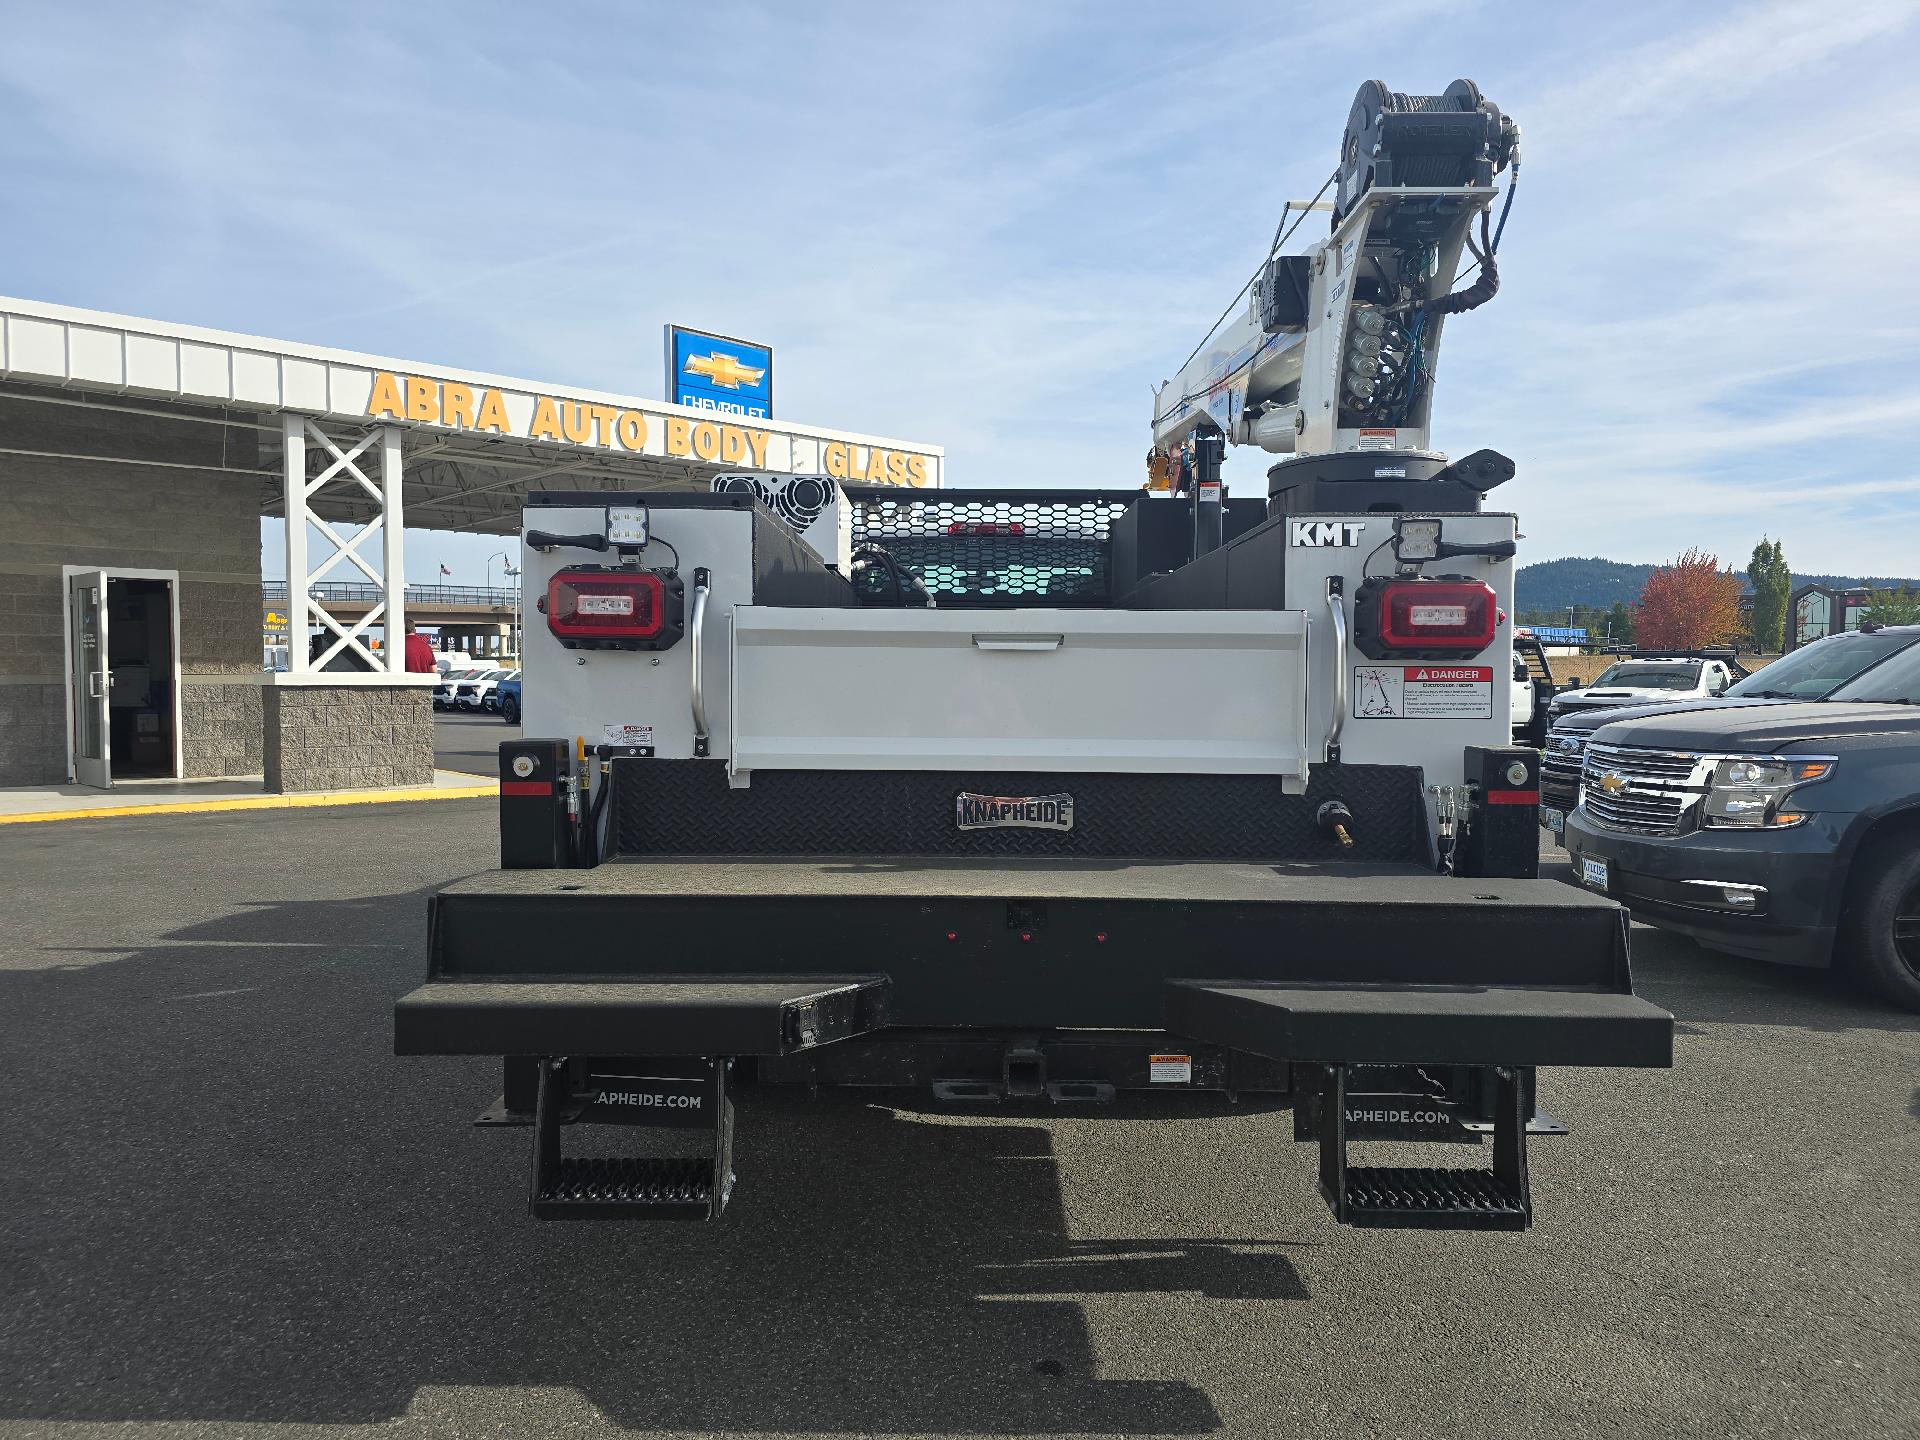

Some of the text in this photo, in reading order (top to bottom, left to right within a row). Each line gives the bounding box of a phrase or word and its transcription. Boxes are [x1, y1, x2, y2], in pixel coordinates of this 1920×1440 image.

[369, 371, 927, 488] ABRA AUTO BODY GLASS
[1292, 522, 1366, 547] KMT
[1431, 670, 1479, 679] DANGER
[961, 798, 1069, 826] KNAPHEIDE
